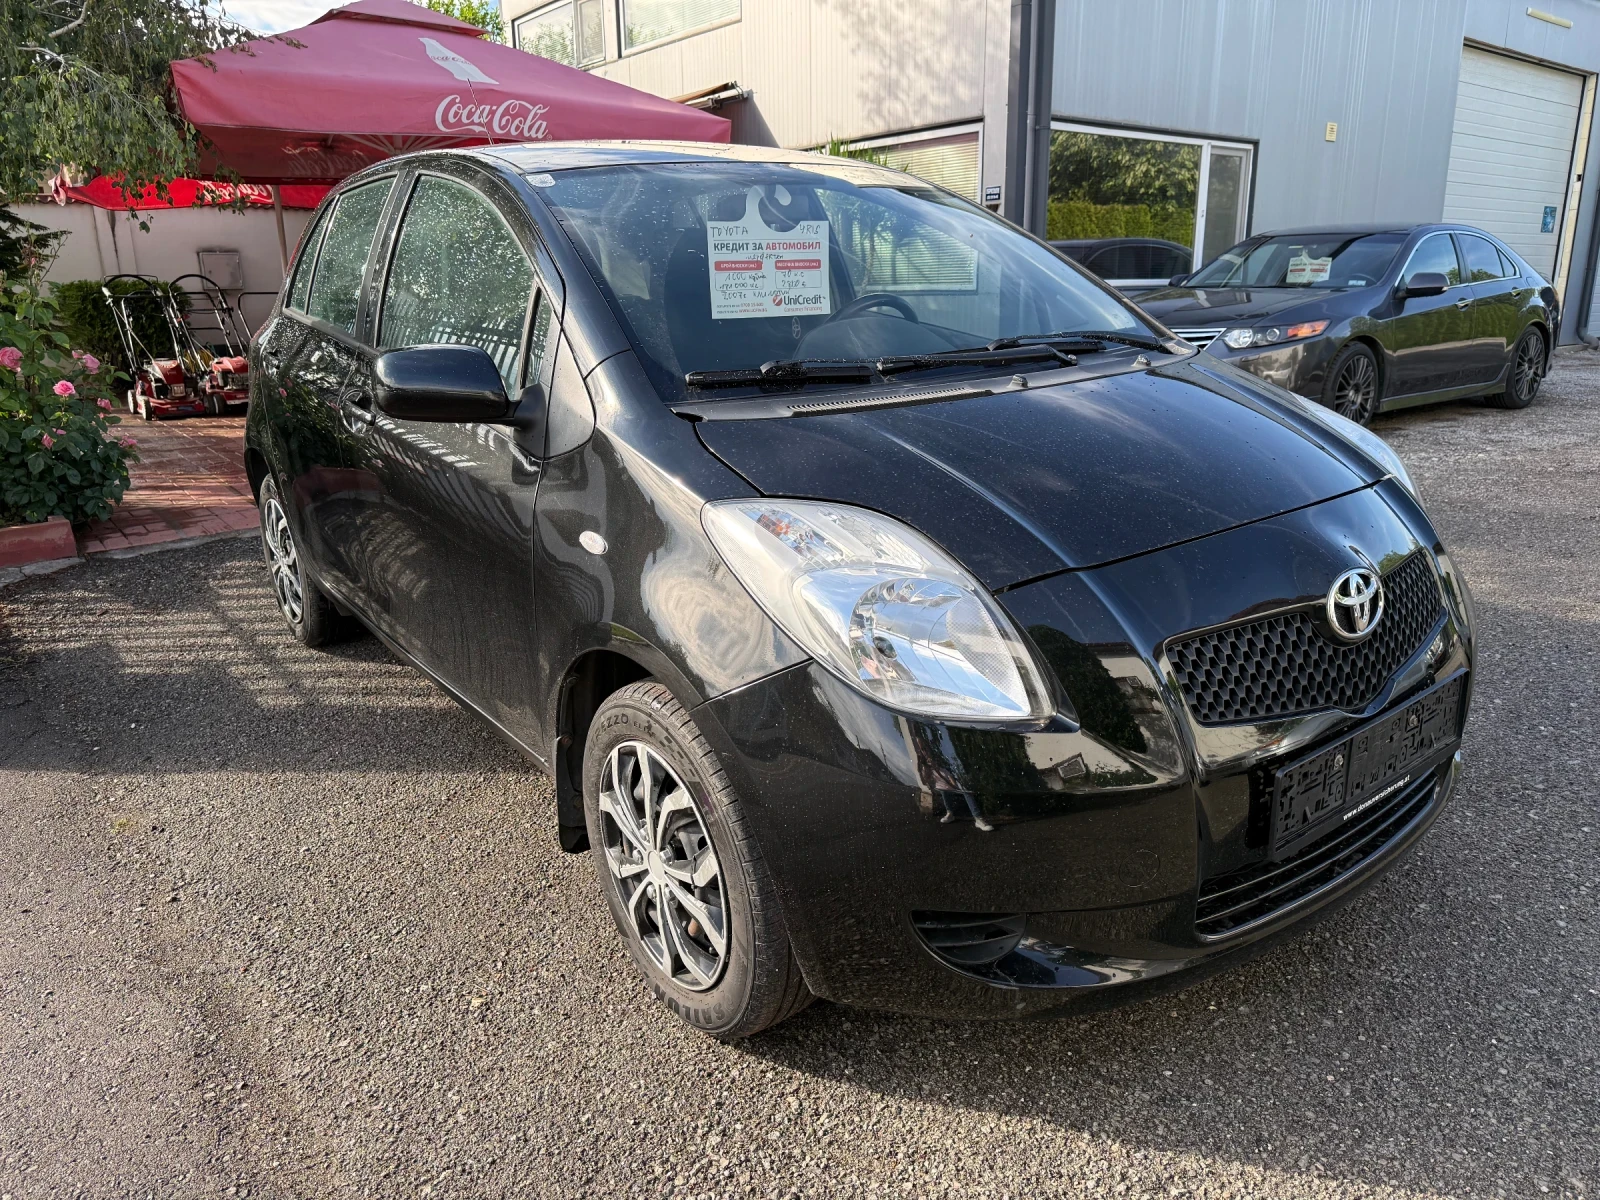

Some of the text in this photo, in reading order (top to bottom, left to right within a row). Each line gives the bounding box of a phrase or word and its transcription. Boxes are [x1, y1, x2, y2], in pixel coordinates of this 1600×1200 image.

[435, 94, 550, 139] Coca-Cola
[710, 226, 749, 238] TOYOTA
[713, 241, 821, 253] КРЕДИТ ЗА АВТОМОБИЛ
[783, 294, 822, 306] UniCredit
[1343, 774, 1411, 821] www.donauversicherung.at
